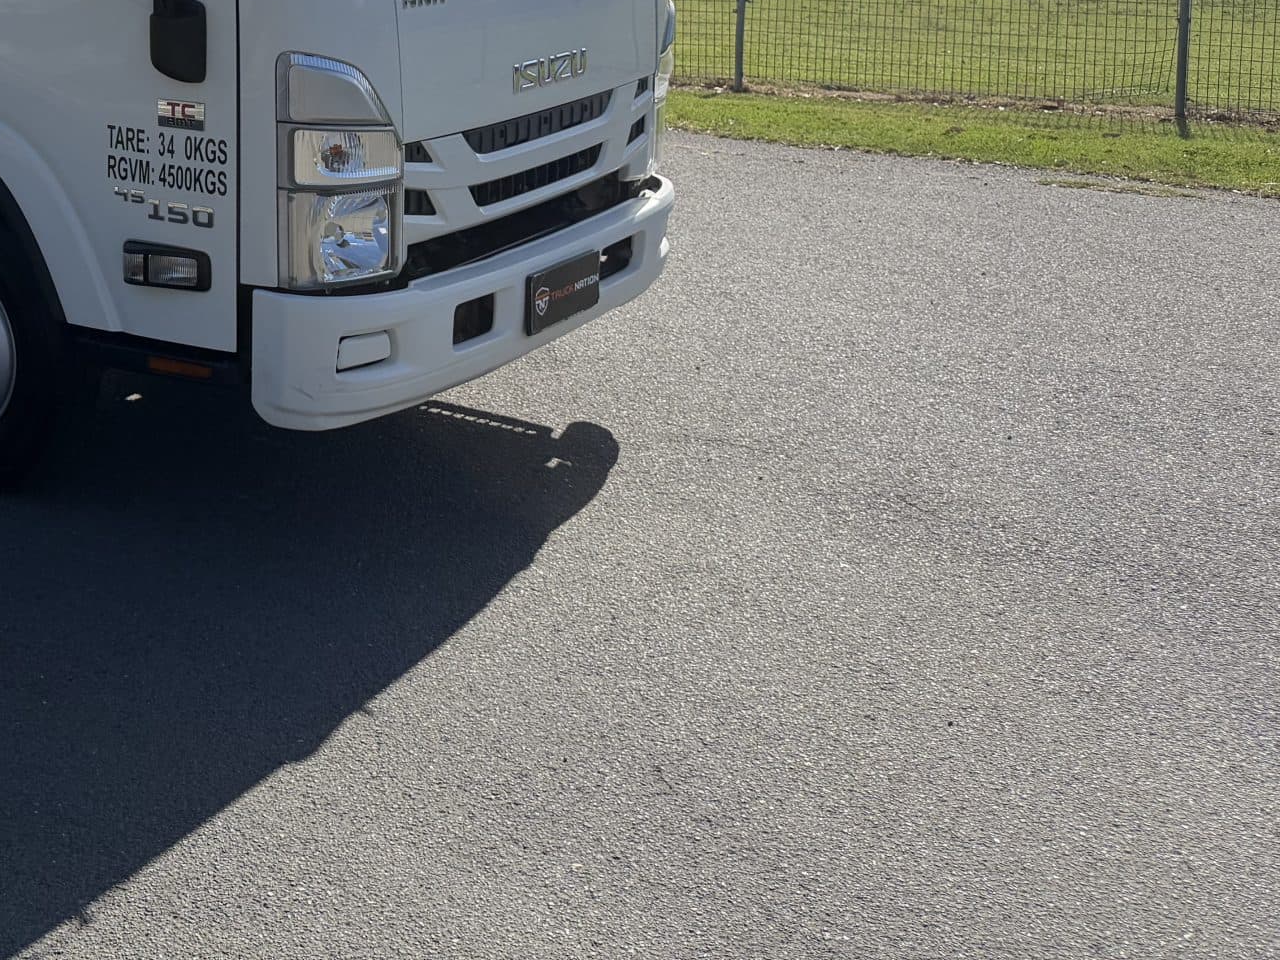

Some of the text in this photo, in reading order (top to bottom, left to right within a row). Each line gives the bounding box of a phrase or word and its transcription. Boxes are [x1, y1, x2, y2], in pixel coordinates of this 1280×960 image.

[513, 47, 588, 95] ISUZU
[166, 101, 196, 119] TC
[107, 124, 150, 155] TARE:
[107, 155, 228, 197] RGVM: 4500KGS
[148, 199, 214, 229] 150
[574, 273, 600, 291] NATION
